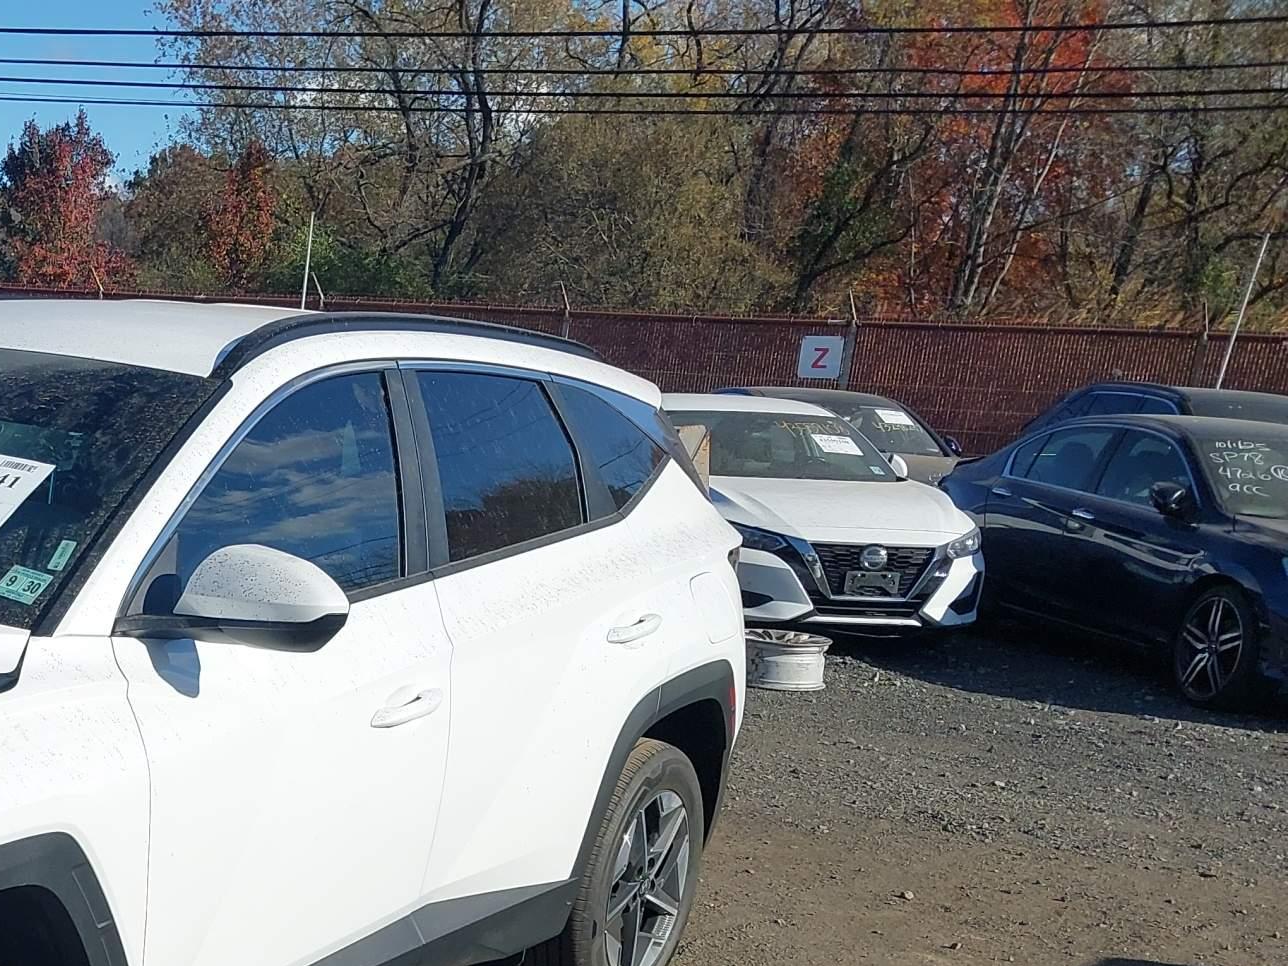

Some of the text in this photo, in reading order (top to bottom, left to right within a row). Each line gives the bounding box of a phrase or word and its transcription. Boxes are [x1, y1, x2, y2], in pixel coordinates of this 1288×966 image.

[811, 347, 829, 368] Z
[6, 575, 18, 587] 9
[22, 580, 42, 595] 30
